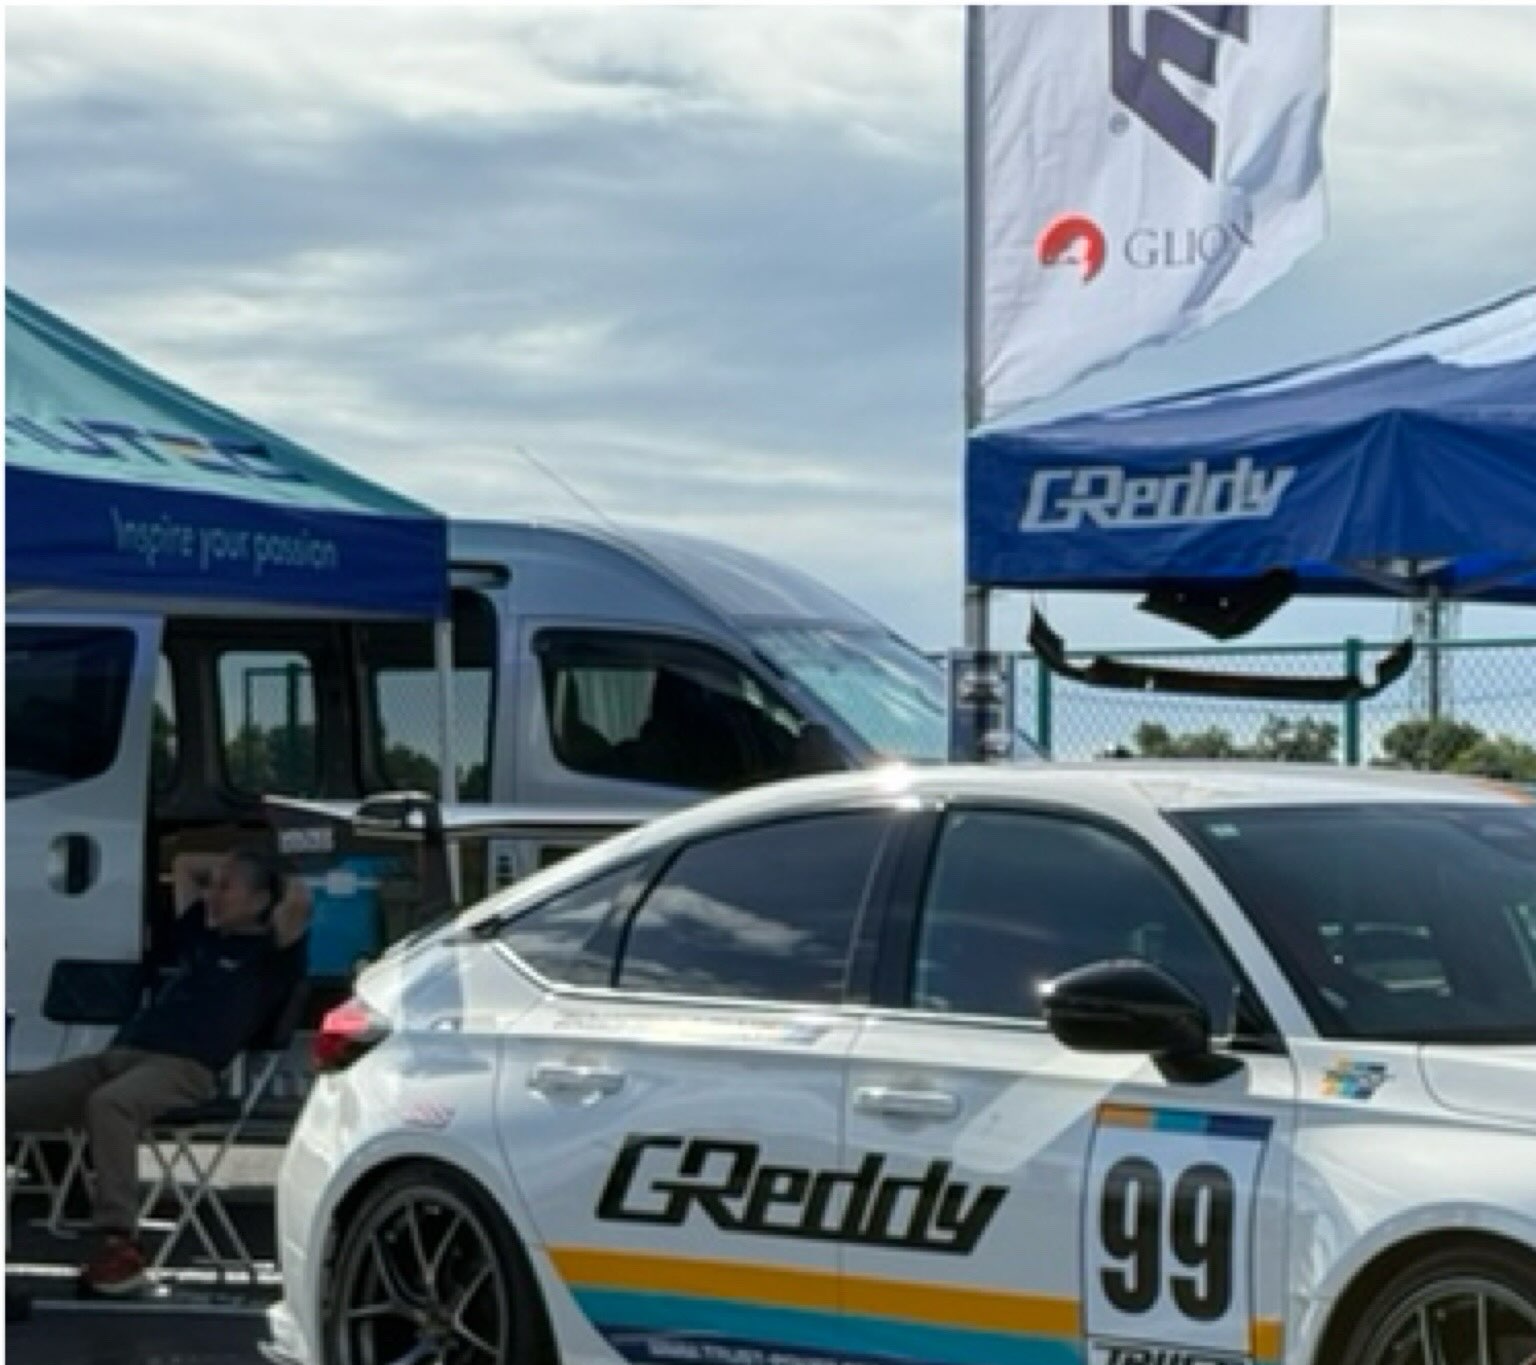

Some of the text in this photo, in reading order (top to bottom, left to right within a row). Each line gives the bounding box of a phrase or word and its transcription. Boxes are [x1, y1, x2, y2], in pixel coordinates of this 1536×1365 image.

[110, 505, 339, 577] Inspire your passion
[1018, 456, 1298, 534] GReddy
[594, 1132, 1010, 1257] GReddy
[1098, 1154, 1238, 1322] 99
